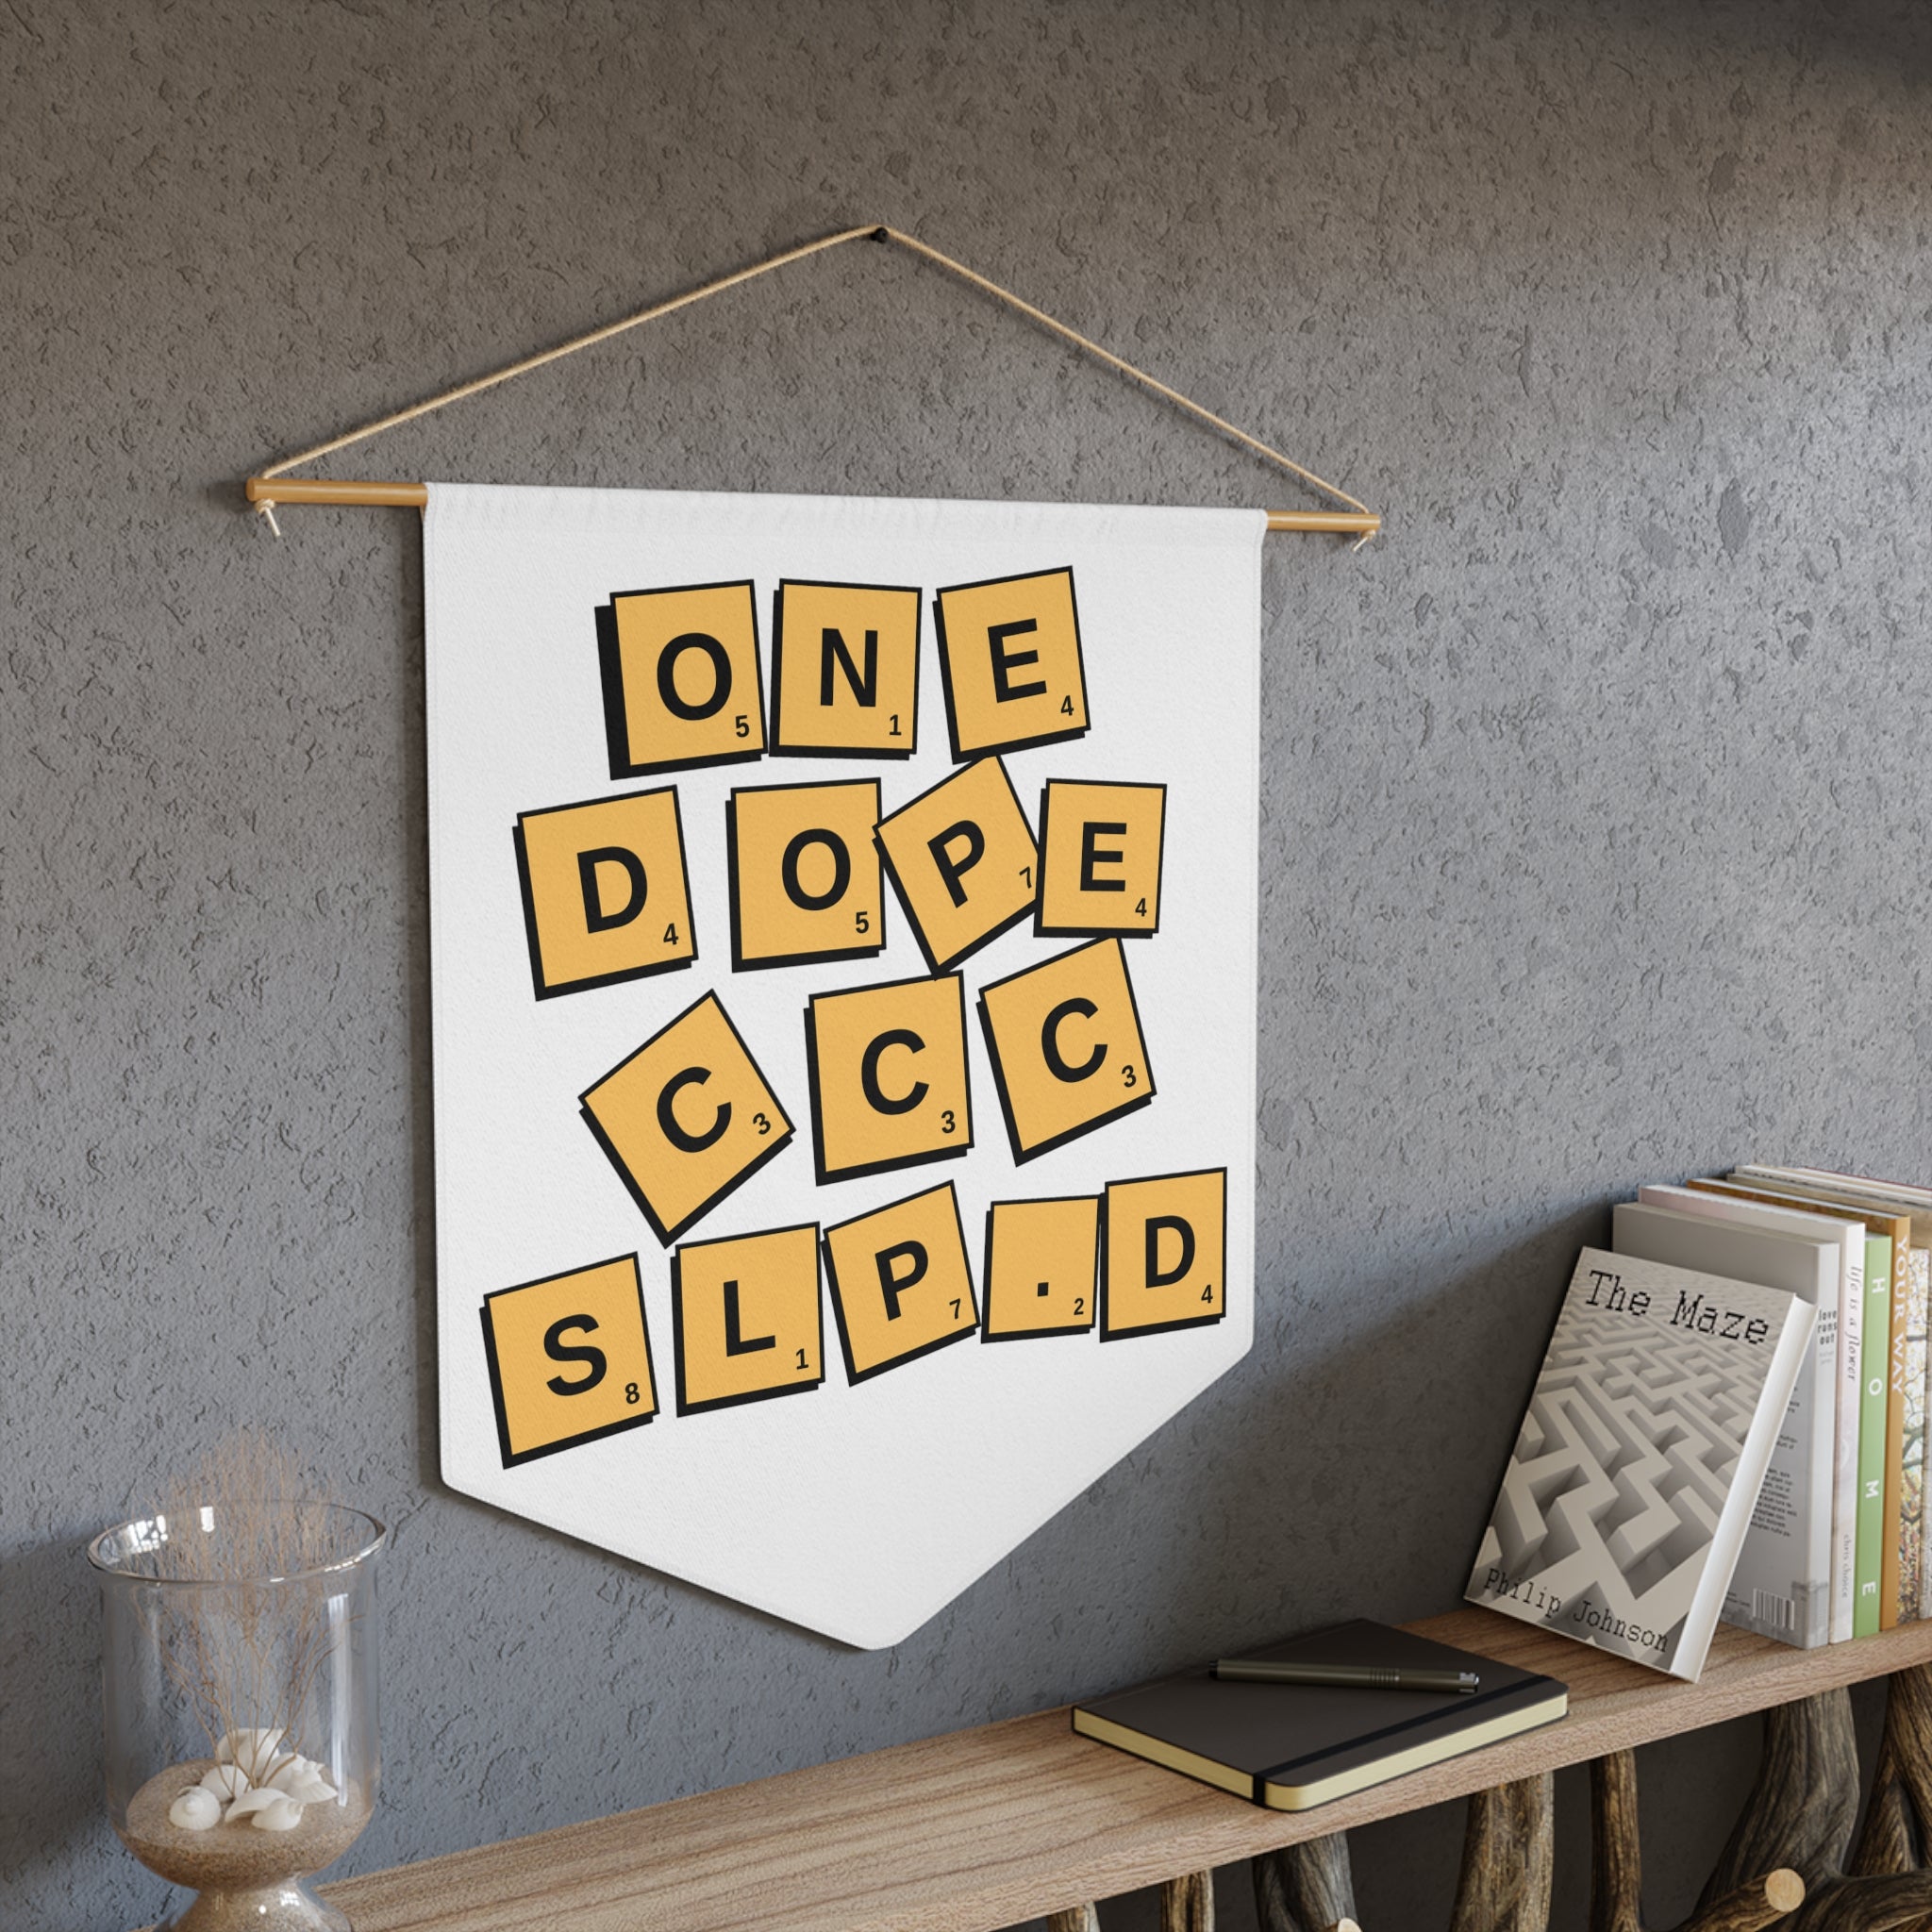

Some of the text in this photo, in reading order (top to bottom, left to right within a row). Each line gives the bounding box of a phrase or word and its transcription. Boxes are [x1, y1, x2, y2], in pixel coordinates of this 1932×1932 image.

[657, 618, 1047, 722] ONE
[1060, 694, 1074, 717] 4
[735, 714, 750, 738] 5
[889, 714, 902, 737] 1
[576, 820, 1127, 934] DOPE
[1019, 866, 1032, 889] 7
[1135, 897, 1147, 917] 4
[855, 910, 870, 934] 5
[662, 923, 679, 946] 4
[656, 997, 1108, 1154] CCC
[1121, 1064, 1137, 1088] 3
[752, 1112, 772, 1135] 3
[941, 1109, 956, 1134] 3
[1846, 1265, 1862, 1291] life
[1201, 1284, 1214, 1304] 4
[1848, 1302, 1857, 1310] is
[948, 1298, 962, 1321] 7
[1074, 1297, 1084, 1316] 2
[1586, 1270, 1769, 1344] The Maze
[1892, 1236, 1907, 1394] YOUR WAY
[795, 1348, 809, 1371] 1
[1844, 1332, 1860, 1382] flower
[625, 1382, 641, 1405] 8
[1861, 1276, 1886, 1597] HOME
[1484, 1568, 1669, 1652] Philip Johnson
